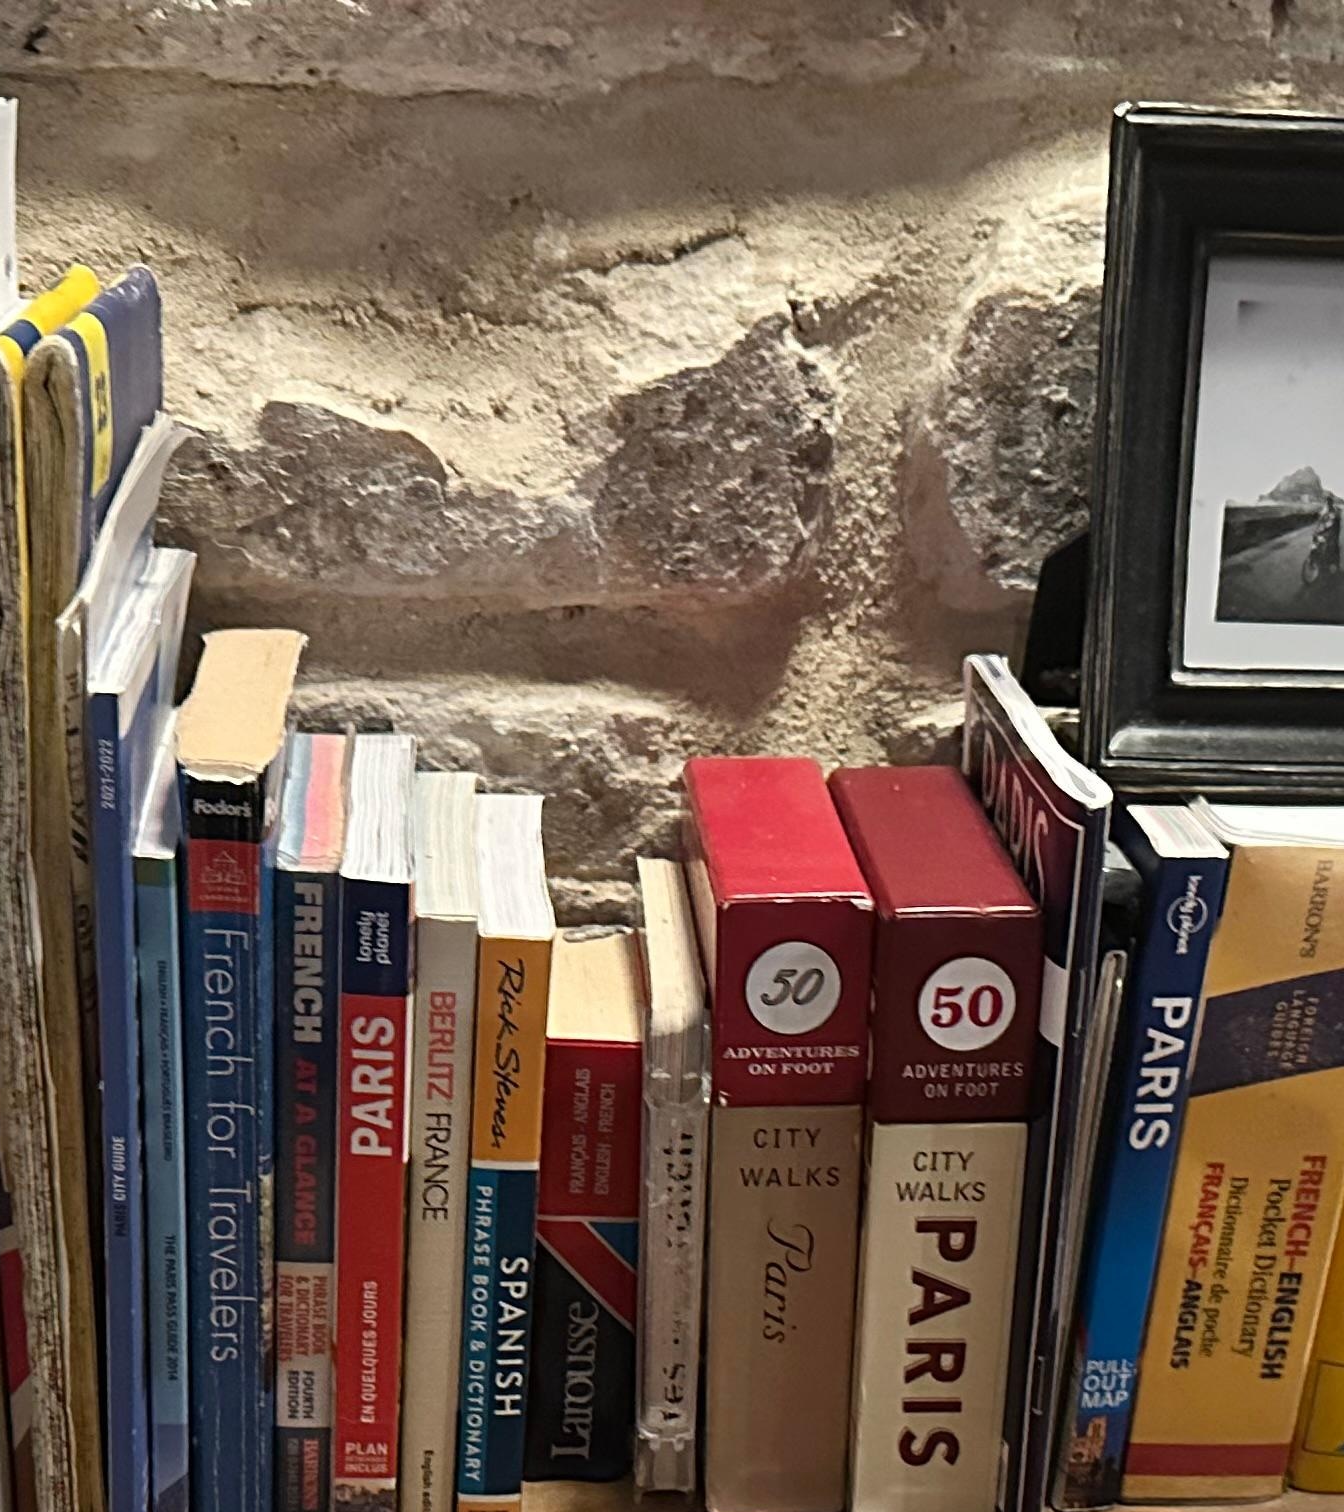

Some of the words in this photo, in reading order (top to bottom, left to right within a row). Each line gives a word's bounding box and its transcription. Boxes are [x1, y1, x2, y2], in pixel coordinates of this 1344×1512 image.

[97, 738, 116, 810] 2021-2022
[293, 882, 323, 1043] FRENCH
[356, 910, 377, 963] lonely
[374, 911, 392, 966] planet
[203, 929, 254, 1076] French
[497, 959, 525, 1042] Rick
[760, 968, 825, 1006] 50
[931, 985, 1004, 1028] 50
[426, 991, 456, 1101] BERLITZ
[723, 1045, 860, 1060] ADVENTURES
[1267, 1001, 1289, 1058] GUIDES
[1279, 989, 1306, 1073] LANGUAGE
[1295, 997, 1320, 1063] FOREIGN
[295, 1058, 317, 1093] AT
[351, 1015, 395, 1157] PARIS
[748, 1062, 777, 1076] ON
[781, 1062, 834, 1075] FOOT
[902, 1062, 1024, 1080] ADVENTURES
[924, 1083, 948, 1098] ON
[955, 1082, 1000, 1097] FOOT
[1129, 997, 1193, 1151] PARIS
[294, 1103, 316, 1125] A
[573, 1067, 591, 1126] ANGLAIS
[598, 1083, 616, 1134] FRENCH
[111, 1135, 126, 1169] GUIDE
[206, 1102, 256, 1160] for
[753, 1127, 822, 1150] CITY
[112, 1170, 127, 1201] CITY
[422, 1112, 452, 1221] FRANCE
[569, 1132, 591, 1194] FRANÇAIS
[593, 1144, 611, 1197] ENGLISH
[739, 1166, 841, 1188] WALKS
[912, 1151, 975, 1172] CITY
[293, 1139, 317, 1245] GLANCE
[895, 1181, 987, 1202] WALKS
[1257, 1178, 1292, 1248] Pocket
[472, 1185, 493, 1267] PHRASE
[1212, 1177, 1249, 1280] Dictionnaire
[165, 1258, 176, 1288] PARIS
[208, 1181, 257, 1361] Travelers
[279, 1274, 294, 1295] FOR
[762, 1216, 815, 1344] Paris
[1207, 1283, 1229, 1305] de
[166, 1291, 177, 1317] PASS
[294, 1287, 310, 1357] DICTIONARY
[312, 1275, 327, 1320] PHRASE
[361, 1281, 378, 1326] JOURS
[470, 1275, 490, 1333] BOOK
[1231, 1254, 1276, 1358] Dictionary
[166, 1320, 178, 1353] GUIDE
[278, 1301, 294, 1362] TRAVELERS
[311, 1324, 326, 1355] BOOK
[469, 1341, 487, 1352] &
[494, 1257, 530, 1417] SPANISH
[897, 1215, 977, 1467] PARIS
[1198, 1306, 1220, 1358] poche
[167, 1356, 178, 1381] 2014
[360, 1329, 378, 1403] QUELQUES
[551, 1301, 599, 1460] Larousse
[1083, 1373, 1132, 1392] OUT
[287, 1370, 300, 1419] EDITION
[303, 1370, 315, 1419] FOURTH
[360, 1404, 376, 1424] EN
[1081, 1390, 1129, 1408] MAP
[464, 1360, 485, 1483] DICTIONARY
[345, 1442, 388, 1456] PLAN
[420, 1450, 434, 1488] English
